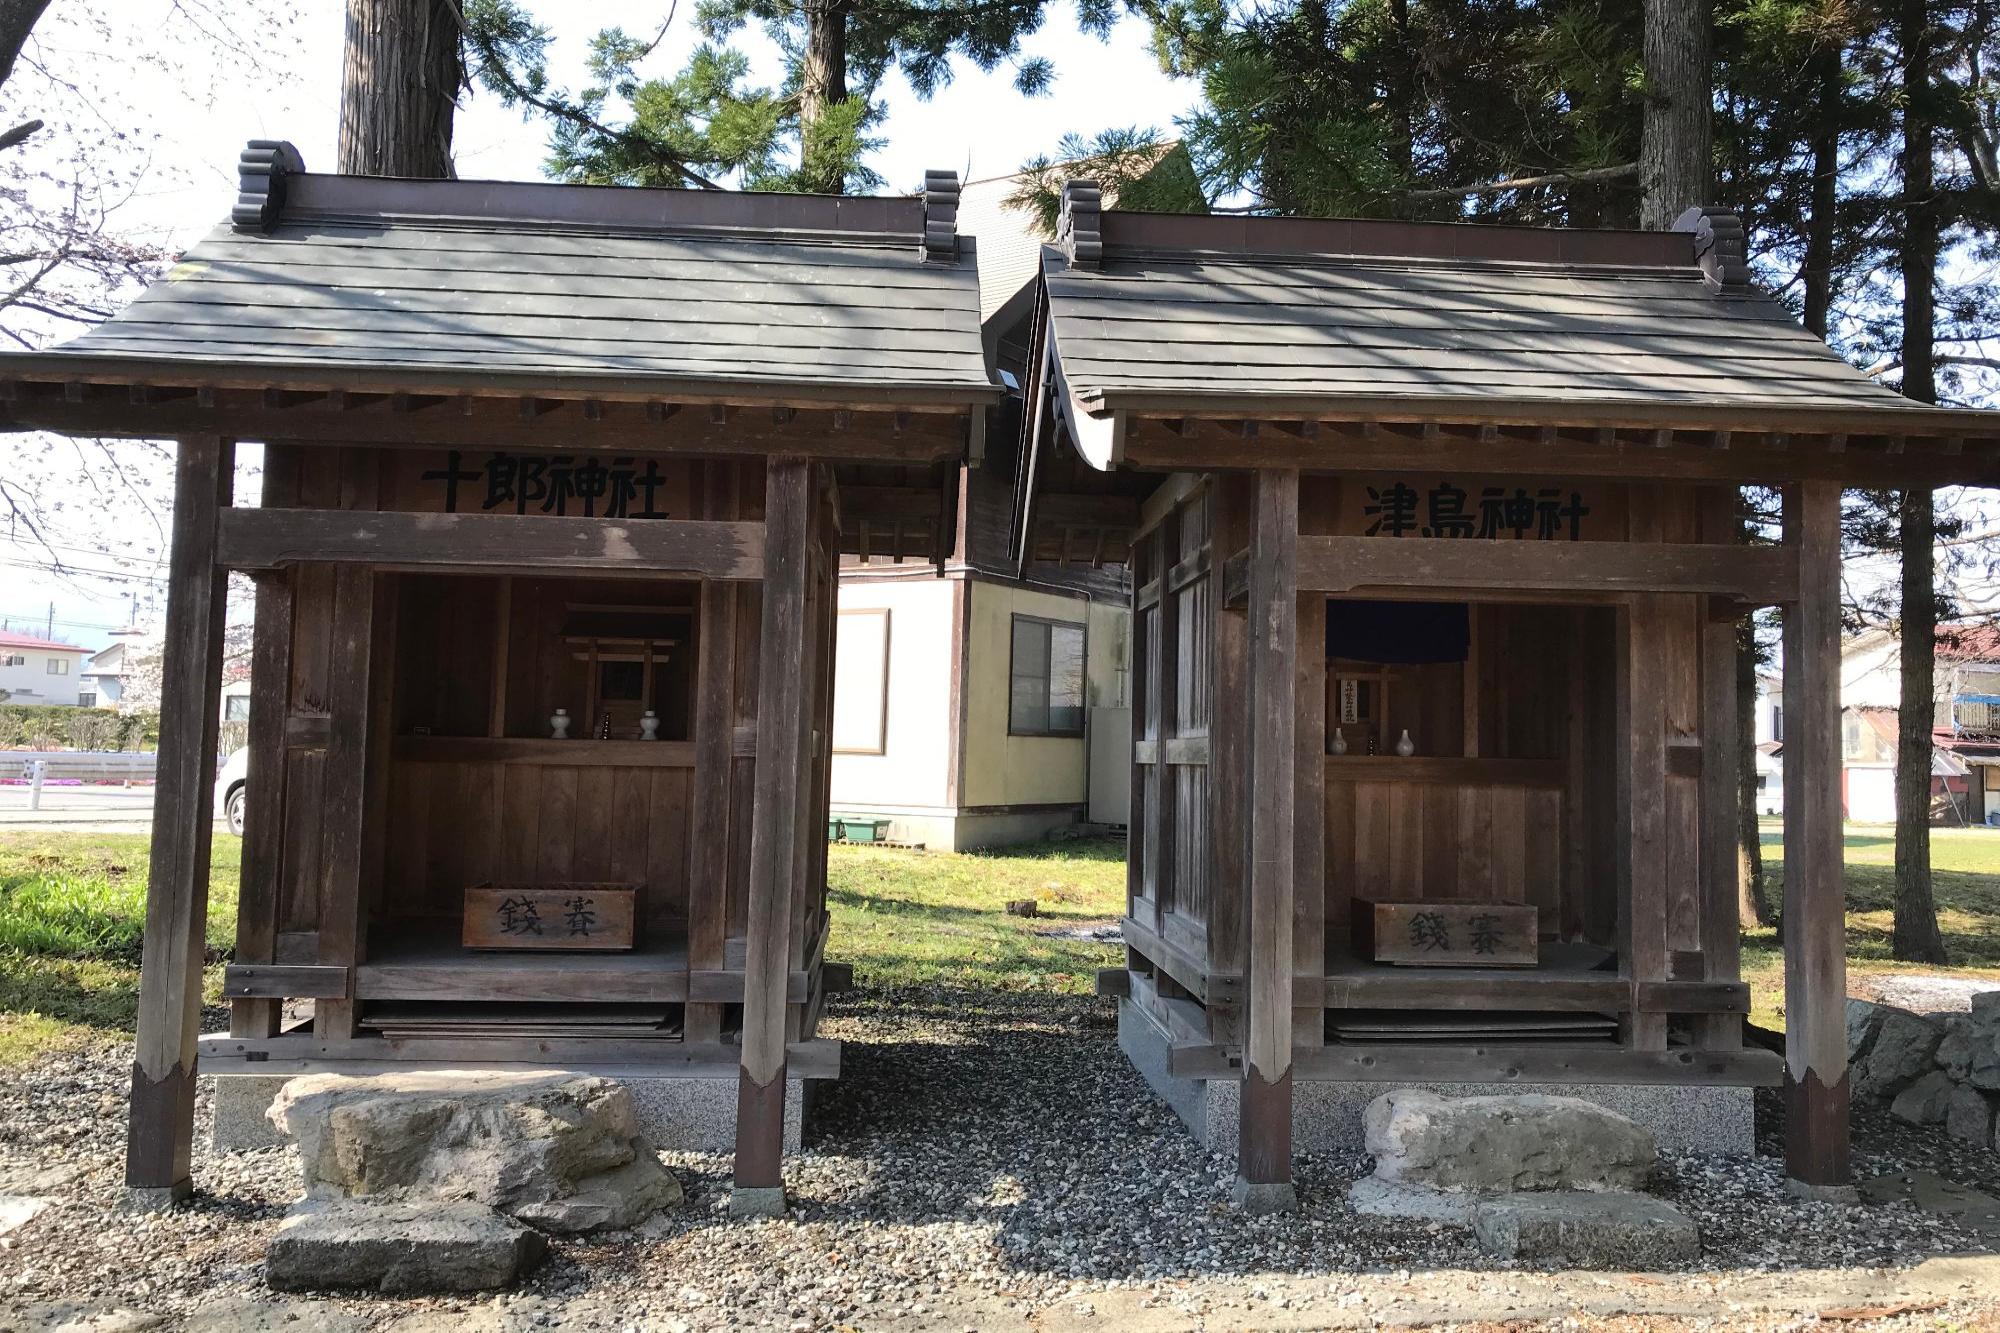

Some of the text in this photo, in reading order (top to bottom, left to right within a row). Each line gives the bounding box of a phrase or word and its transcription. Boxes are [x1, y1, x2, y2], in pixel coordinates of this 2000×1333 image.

[421, 451, 670, 519] 十郎神社
[1364, 482, 1590, 541] 津島神社
